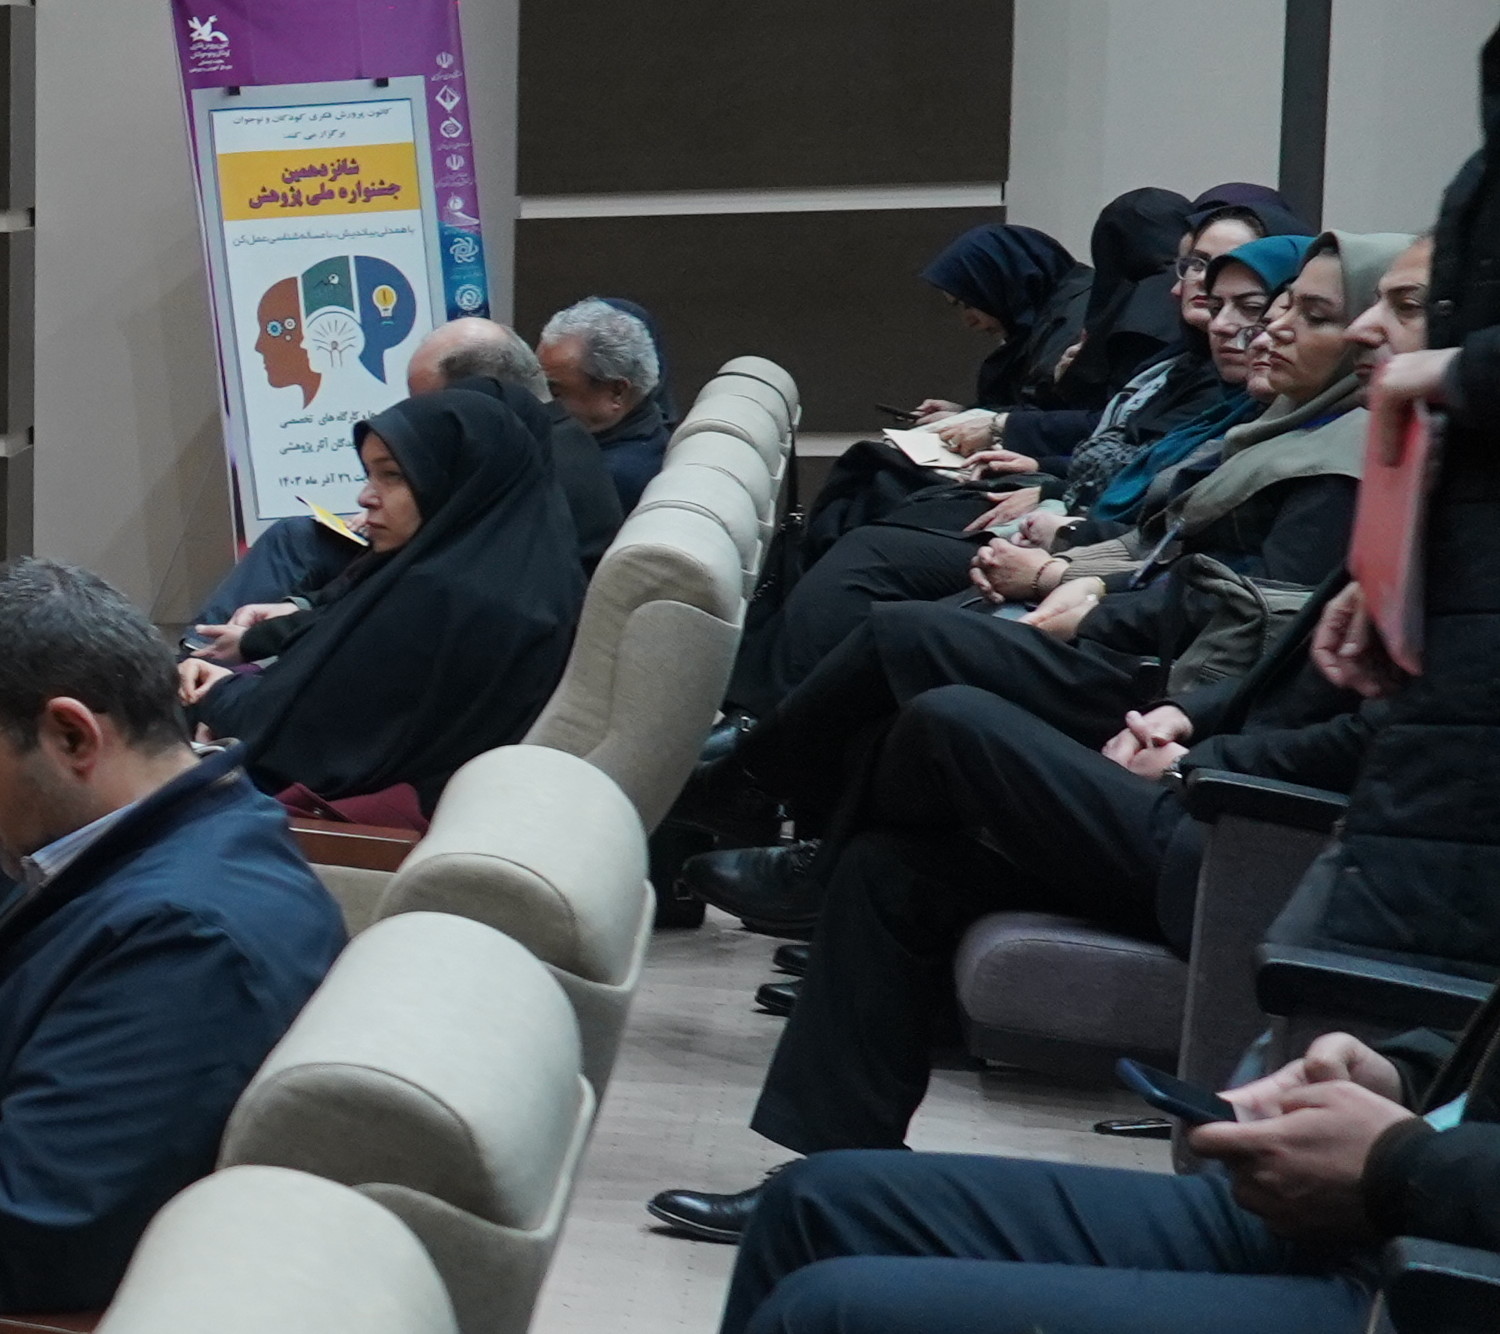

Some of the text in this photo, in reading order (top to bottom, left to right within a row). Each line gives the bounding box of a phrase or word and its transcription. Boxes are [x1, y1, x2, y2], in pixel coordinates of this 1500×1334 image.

[281, 157, 360, 184] شانزدهمین
[248, 179, 402, 210] جشنواره ملی پژوهش
